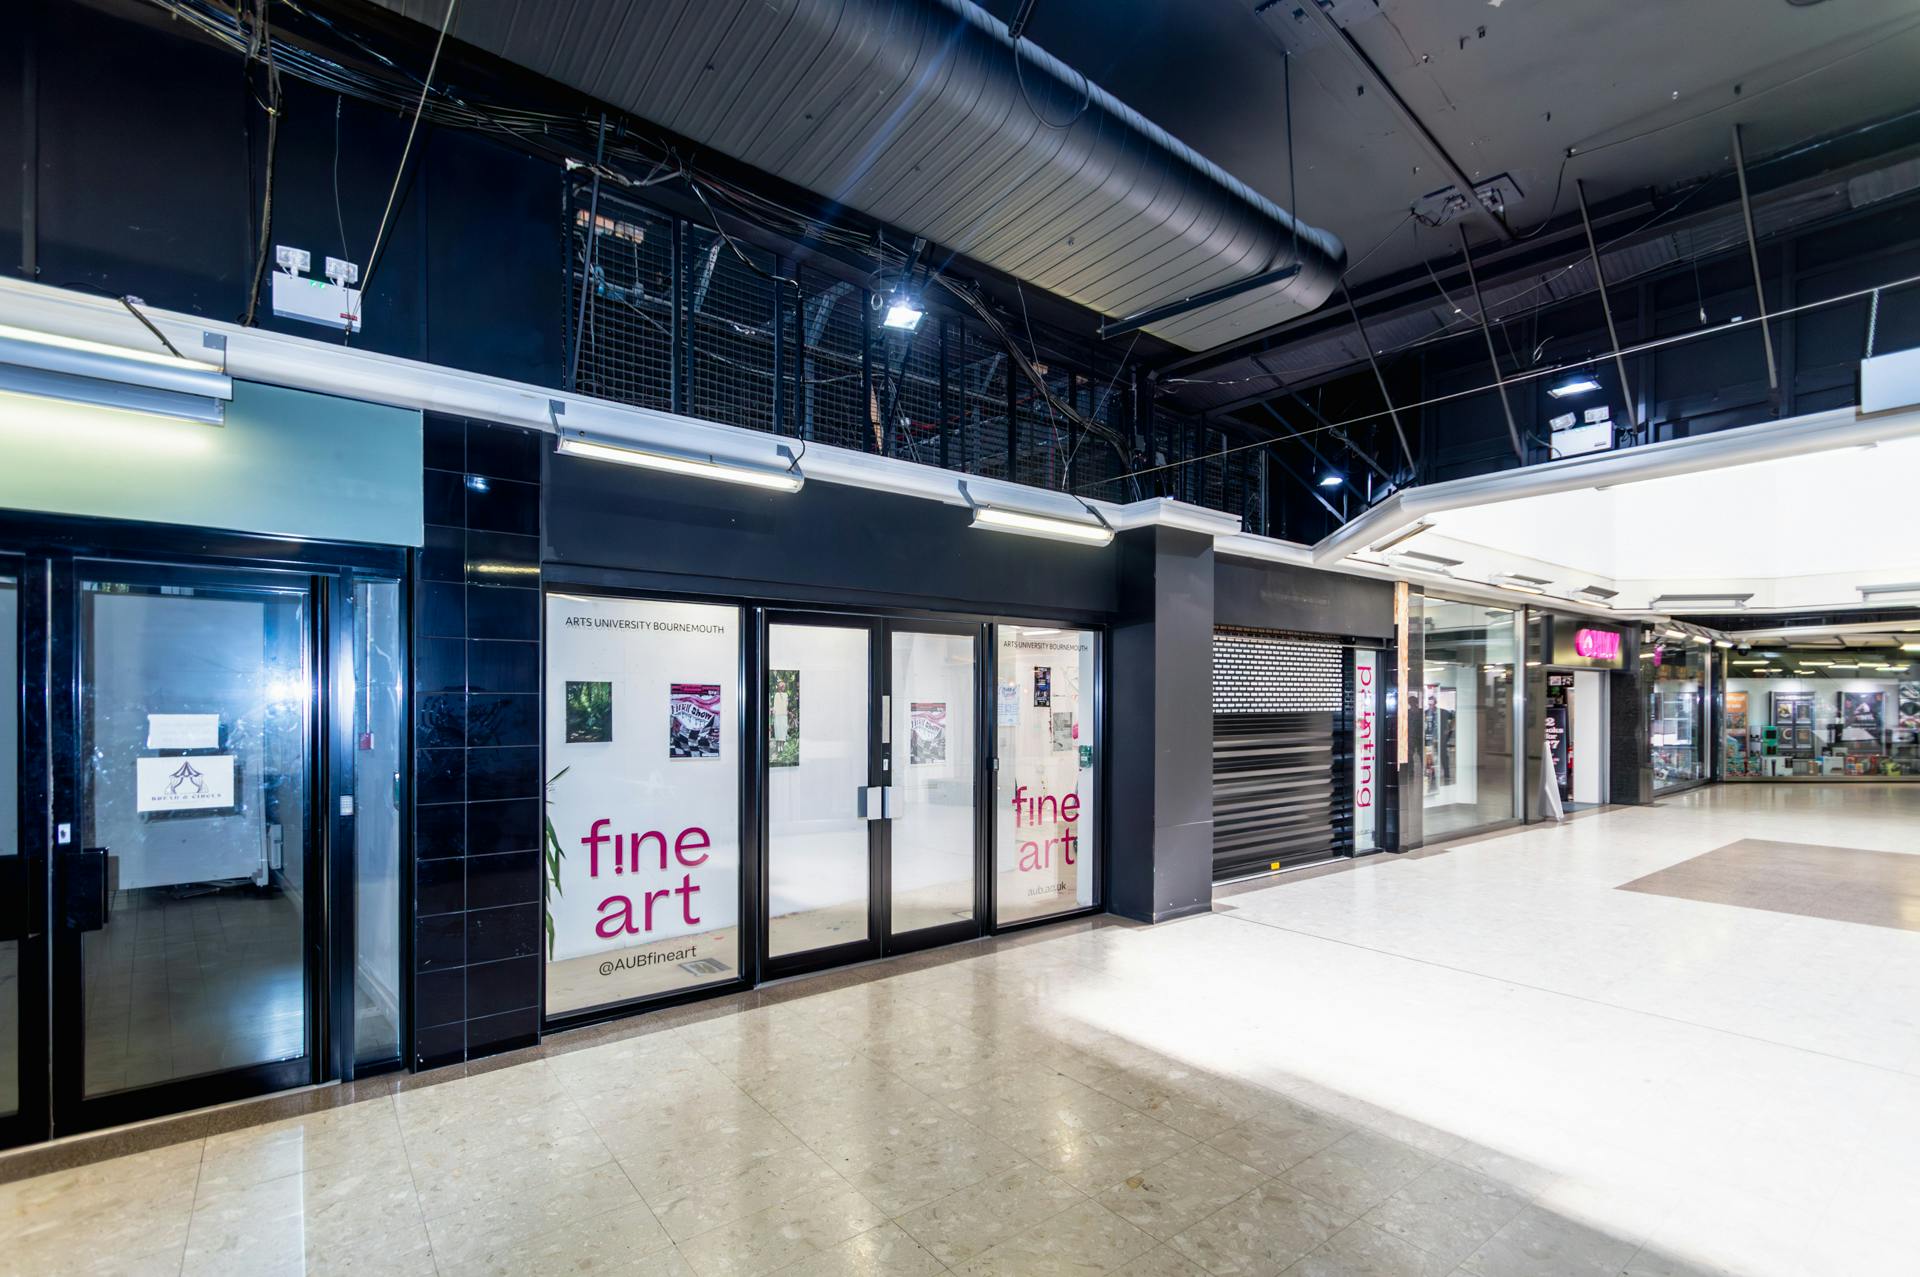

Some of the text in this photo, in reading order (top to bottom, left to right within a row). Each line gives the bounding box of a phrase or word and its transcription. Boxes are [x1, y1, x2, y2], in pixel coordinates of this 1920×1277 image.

[565, 616, 725, 634] ARTS UNIVERSITY BOURNEMOUTH
[1003, 640, 1089, 653] ARTS UNIVERSITY BOURNEMOUTH
[1019, 827, 1077, 872] art
[595, 873, 701, 939] art
[598, 945, 697, 976] @AUBfineart
